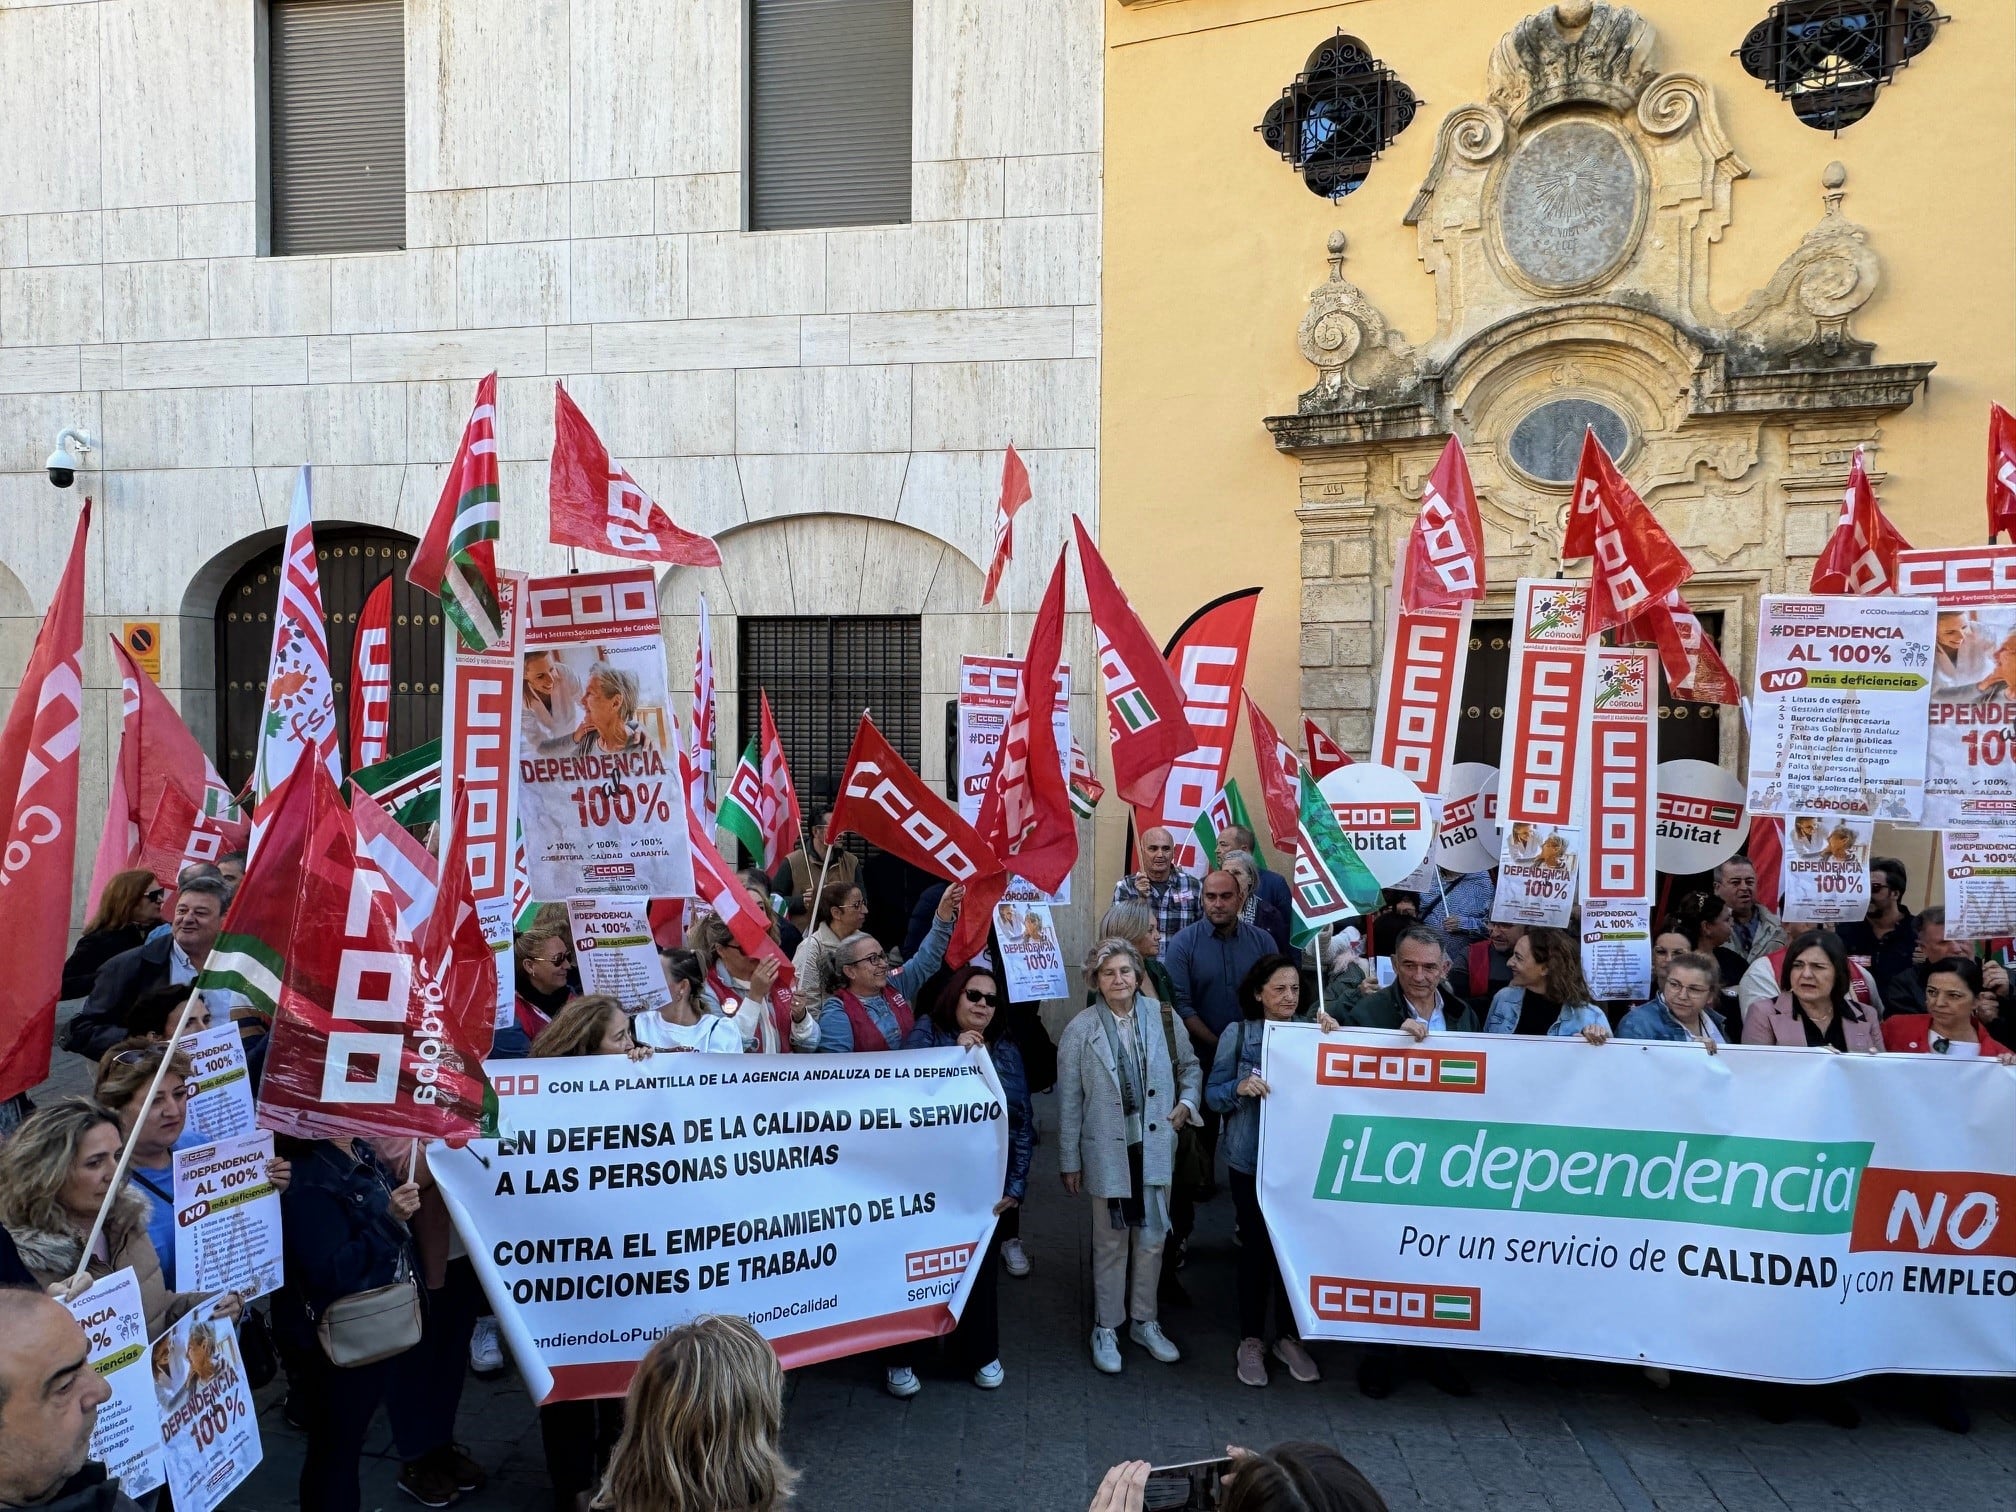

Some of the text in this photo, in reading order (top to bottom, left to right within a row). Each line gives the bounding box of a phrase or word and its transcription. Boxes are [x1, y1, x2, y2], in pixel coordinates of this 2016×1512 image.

[526, 580, 658, 629] COO
[1784, 605, 1816, 613] CCOO
[1769, 625, 1905, 641] #DEPENDENCIA
[1787, 643, 1892, 664] AL 100%
[1768, 671, 1919, 688] NO más deficiencias
[1393, 624, 1447, 783] CCOO
[1779, 704, 1870, 715] 2 Gestión deficiente
[1792, 696, 1818, 704] Listas
[1819, 696, 1831, 704] de
[1832, 697, 1861, 706] espera
[1778, 713, 1891, 726] 3 Burocracia innecesaria
[1928, 702, 2016, 725] EPENDE
[1521, 660, 1572, 815] CCOO
[1790, 733, 1811, 741] Falta
[1813, 734, 1825, 742] de
[1826, 735, 1854, 744] plazas
[1791, 724, 1820, 732] Trabas
[1864, 727, 1900, 735] Andaluz
[1788, 752, 1811, 760] Altos
[1813, 754, 1844, 762] niveles
[1845, 755, 1857, 763] de
[1858, 757, 1890, 766] copago
[1789, 743, 1844, 752] Financiación
[1845, 746, 1898, 755] insuficiente
[519, 750, 667, 784] DEPENDENCIA
[1788, 762, 1809, 770] Falta
[1811, 763, 1823, 771] de
[1824, 765, 1862, 774] personal
[465, 678, 503, 890] CCOO
[601, 768, 625, 799] al
[1787, 773, 1811, 782] Bajos
[1813, 774, 1847, 783] salarios
[1848, 775, 1862, 784] del
[1864, 777, 1903, 787] personal
[1933, 778, 2009, 787] 100% 100%
[1874, 787, 1906, 795] laboral
[571, 782, 671, 828] 100%
[1600, 731, 1637, 890] CCOO
[1656, 798, 1708, 819] COO
[1795, 795, 1869, 812] #CÓRDOBA
[845, 760, 979, 883] CCOO
[1333, 808, 1386, 825] COO
[556, 838, 662, 851] 100% 100% 100%
[1348, 831, 1407, 851] bitat
[1790, 860, 1863, 874] DEPENDENCIA
[1961, 853, 1981, 863] AL
[1503, 863, 1571, 881] DEPENDENCIA
[1952, 868, 1971, 877] NO
[1523, 878, 1568, 900] 100%
[1814, 874, 1863, 894] 100%
[584, 922, 631, 934] AL 100%
[1594, 919, 1634, 929] AL 100%
[580, 939, 594, 949] NO
[1587, 933, 1601, 942] NO
[1024, 953, 1059, 971] 100%
[205, 1053, 234, 1074] 100%
[1325, 1052, 1432, 1083] CCOO
[548, 1067, 911, 1094] CON LA PLANTILLA DE LA AGENCIA ANDALUZA DE LA
[547, 1121, 676, 1154] DEFENSA
[683, 1118, 714, 1144] DE
[720, 1115, 747, 1140] LA
[753, 1109, 852, 1137] CALIDAD
[859, 1106, 902, 1131] DEL
[909, 1099, 1002, 1128] SERVICIO
[182, 1150, 265, 1182] #DEPENDENCIA
[494, 1144, 840, 1196] A LAS PERSONAS USUARIAS
[195, 1164, 259, 1198] AL 100%
[1331, 1126, 2000, 1250] ¡La dependencia NO
[184, 1203, 207, 1223] NO
[493, 1191, 936, 1266] CONTRA EL EMPEORAMIENTO DE LAS
[908, 1247, 970, 1278] CCOO
[1399, 1225, 2016, 1305] Por un servicio de CALIDAD y con EMPLEO
[503, 1242, 837, 1305] ONDICIONES DE TRABAJO
[744, 1294, 838, 1325] tionDeCalidad
[1318, 1285, 1427, 1319] CCOO
[161, 1366, 240, 1445] DEPENDENCIA
[190, 1387, 246, 1454] 100%
[99, 1437, 130, 1455] copago
[108, 1450, 144, 1475] personal
